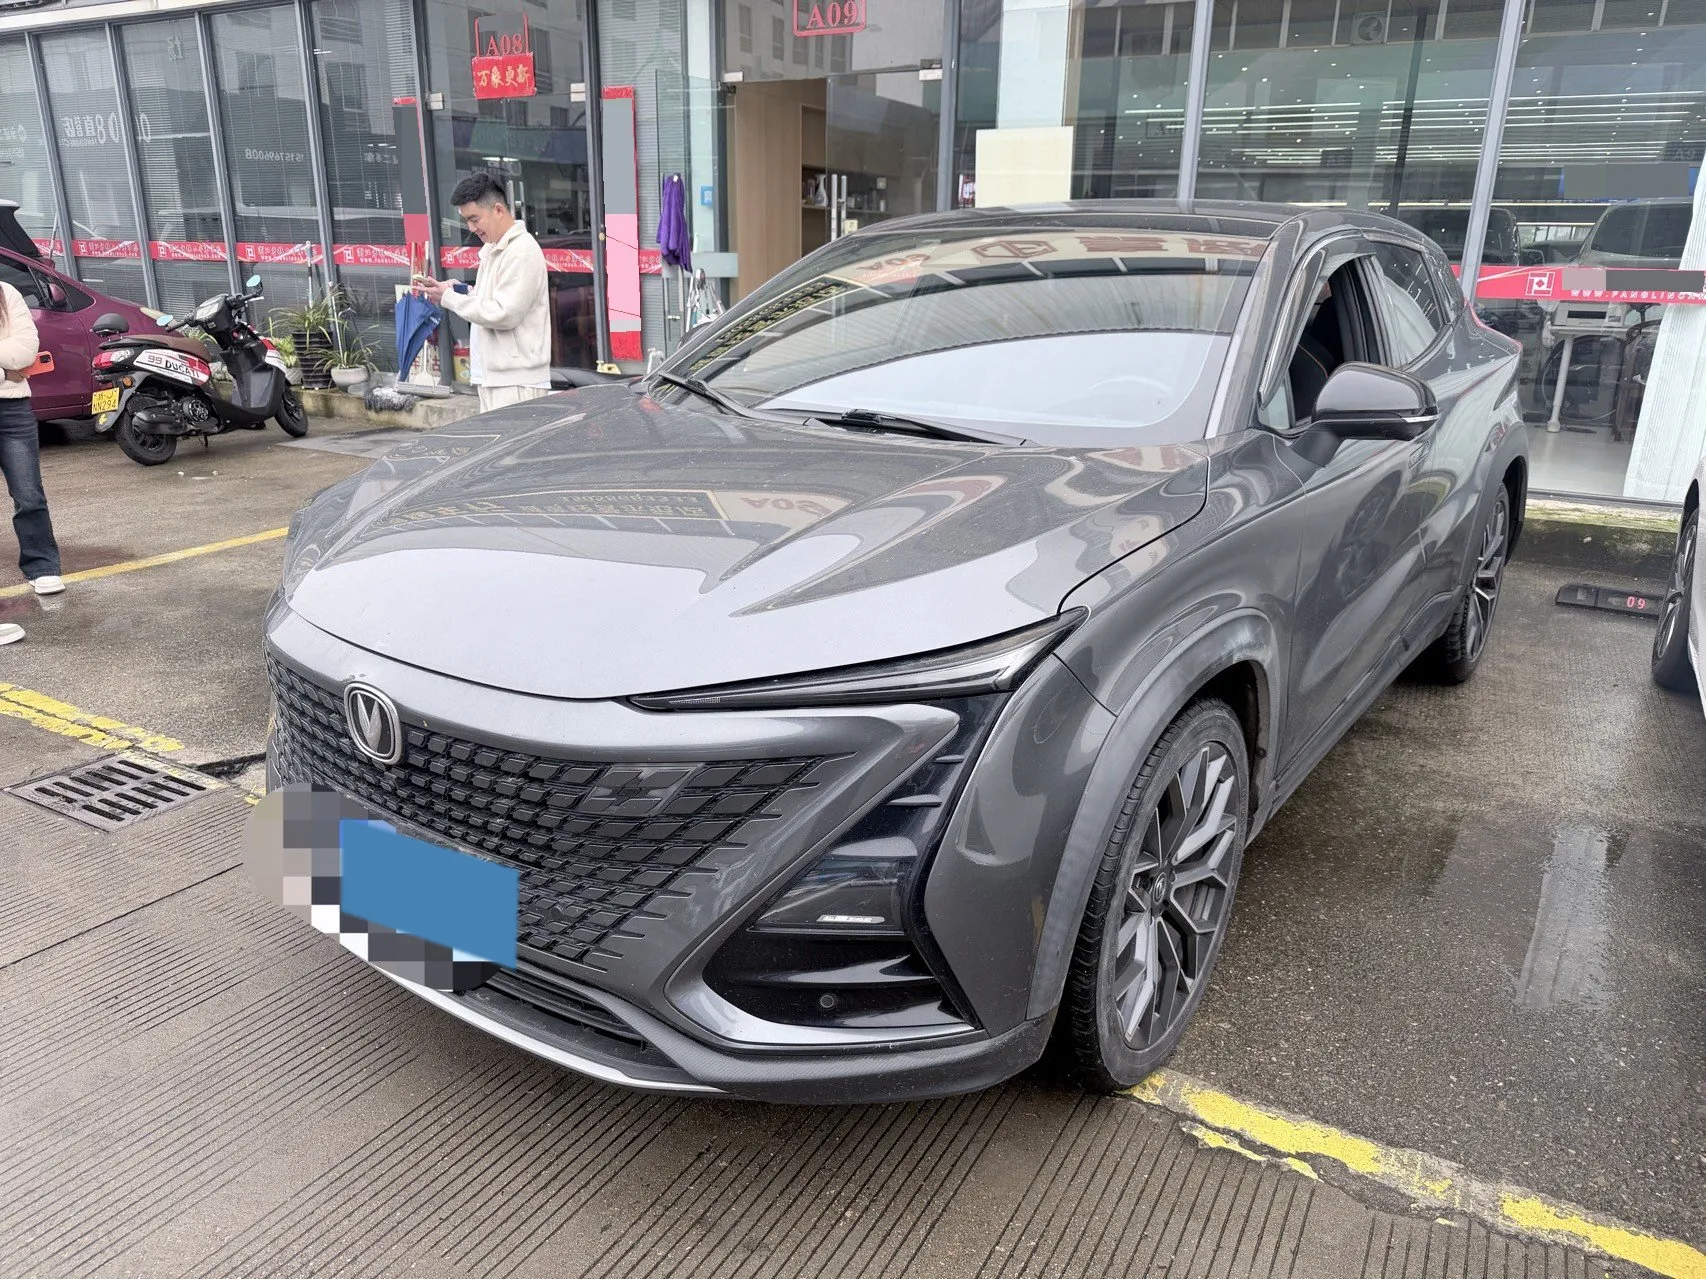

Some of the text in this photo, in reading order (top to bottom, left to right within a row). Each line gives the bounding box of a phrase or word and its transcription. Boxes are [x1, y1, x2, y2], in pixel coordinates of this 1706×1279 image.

[806, 1, 859, 28] A09
[486, 33, 523, 56] A08
[477, 64, 531, 88] 万象更新
[165, 359, 200, 379] DUCATI
[1626, 596, 1646, 609] 09
